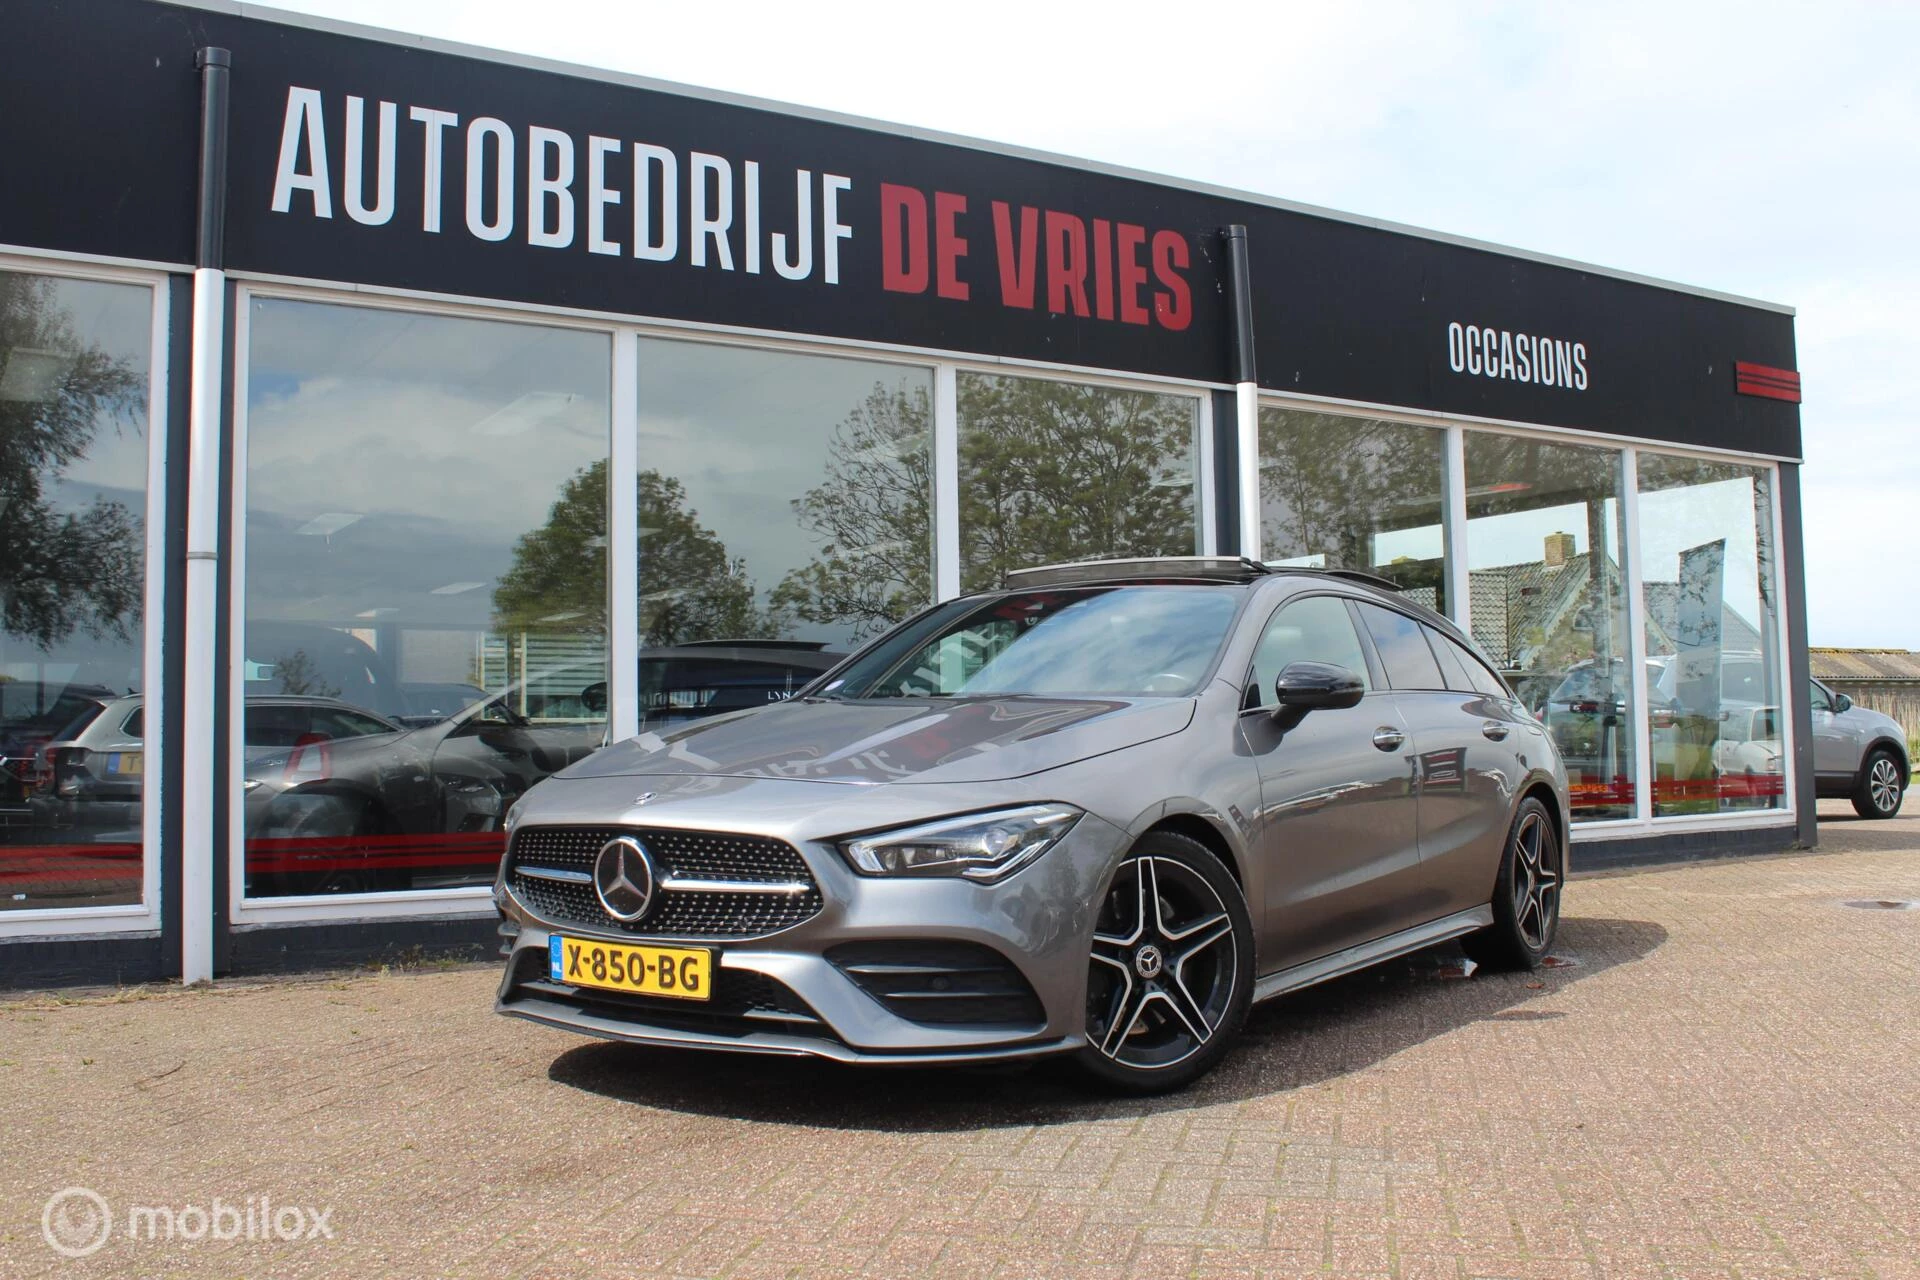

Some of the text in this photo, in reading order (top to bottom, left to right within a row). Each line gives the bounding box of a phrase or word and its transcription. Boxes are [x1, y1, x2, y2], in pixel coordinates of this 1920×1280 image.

[272, 86, 1193, 331] AUTOBEDRIJF DE VRIES
[1449, 321, 1588, 390] OCCASIONS
[552, 961, 562, 973] NL
[568, 944, 699, 991] X-850-BG
